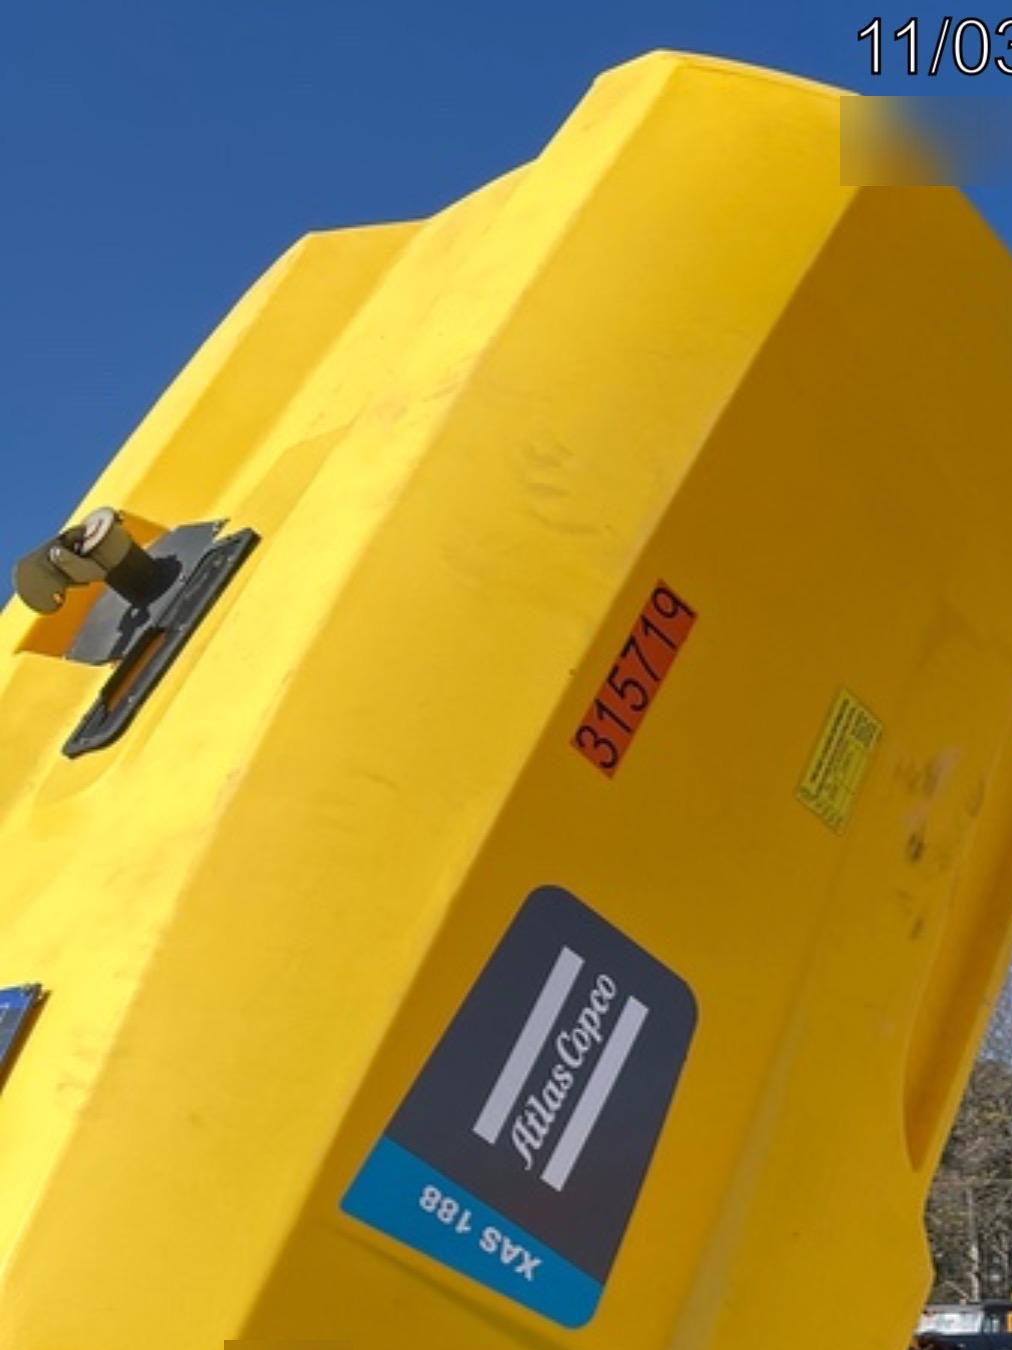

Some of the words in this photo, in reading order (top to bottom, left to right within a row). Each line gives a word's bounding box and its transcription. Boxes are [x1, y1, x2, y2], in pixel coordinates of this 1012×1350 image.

[574, 586, 696, 770] 315719
[419, 1184, 472, 1234] 188
[479, 1226, 542, 1282] XAS
